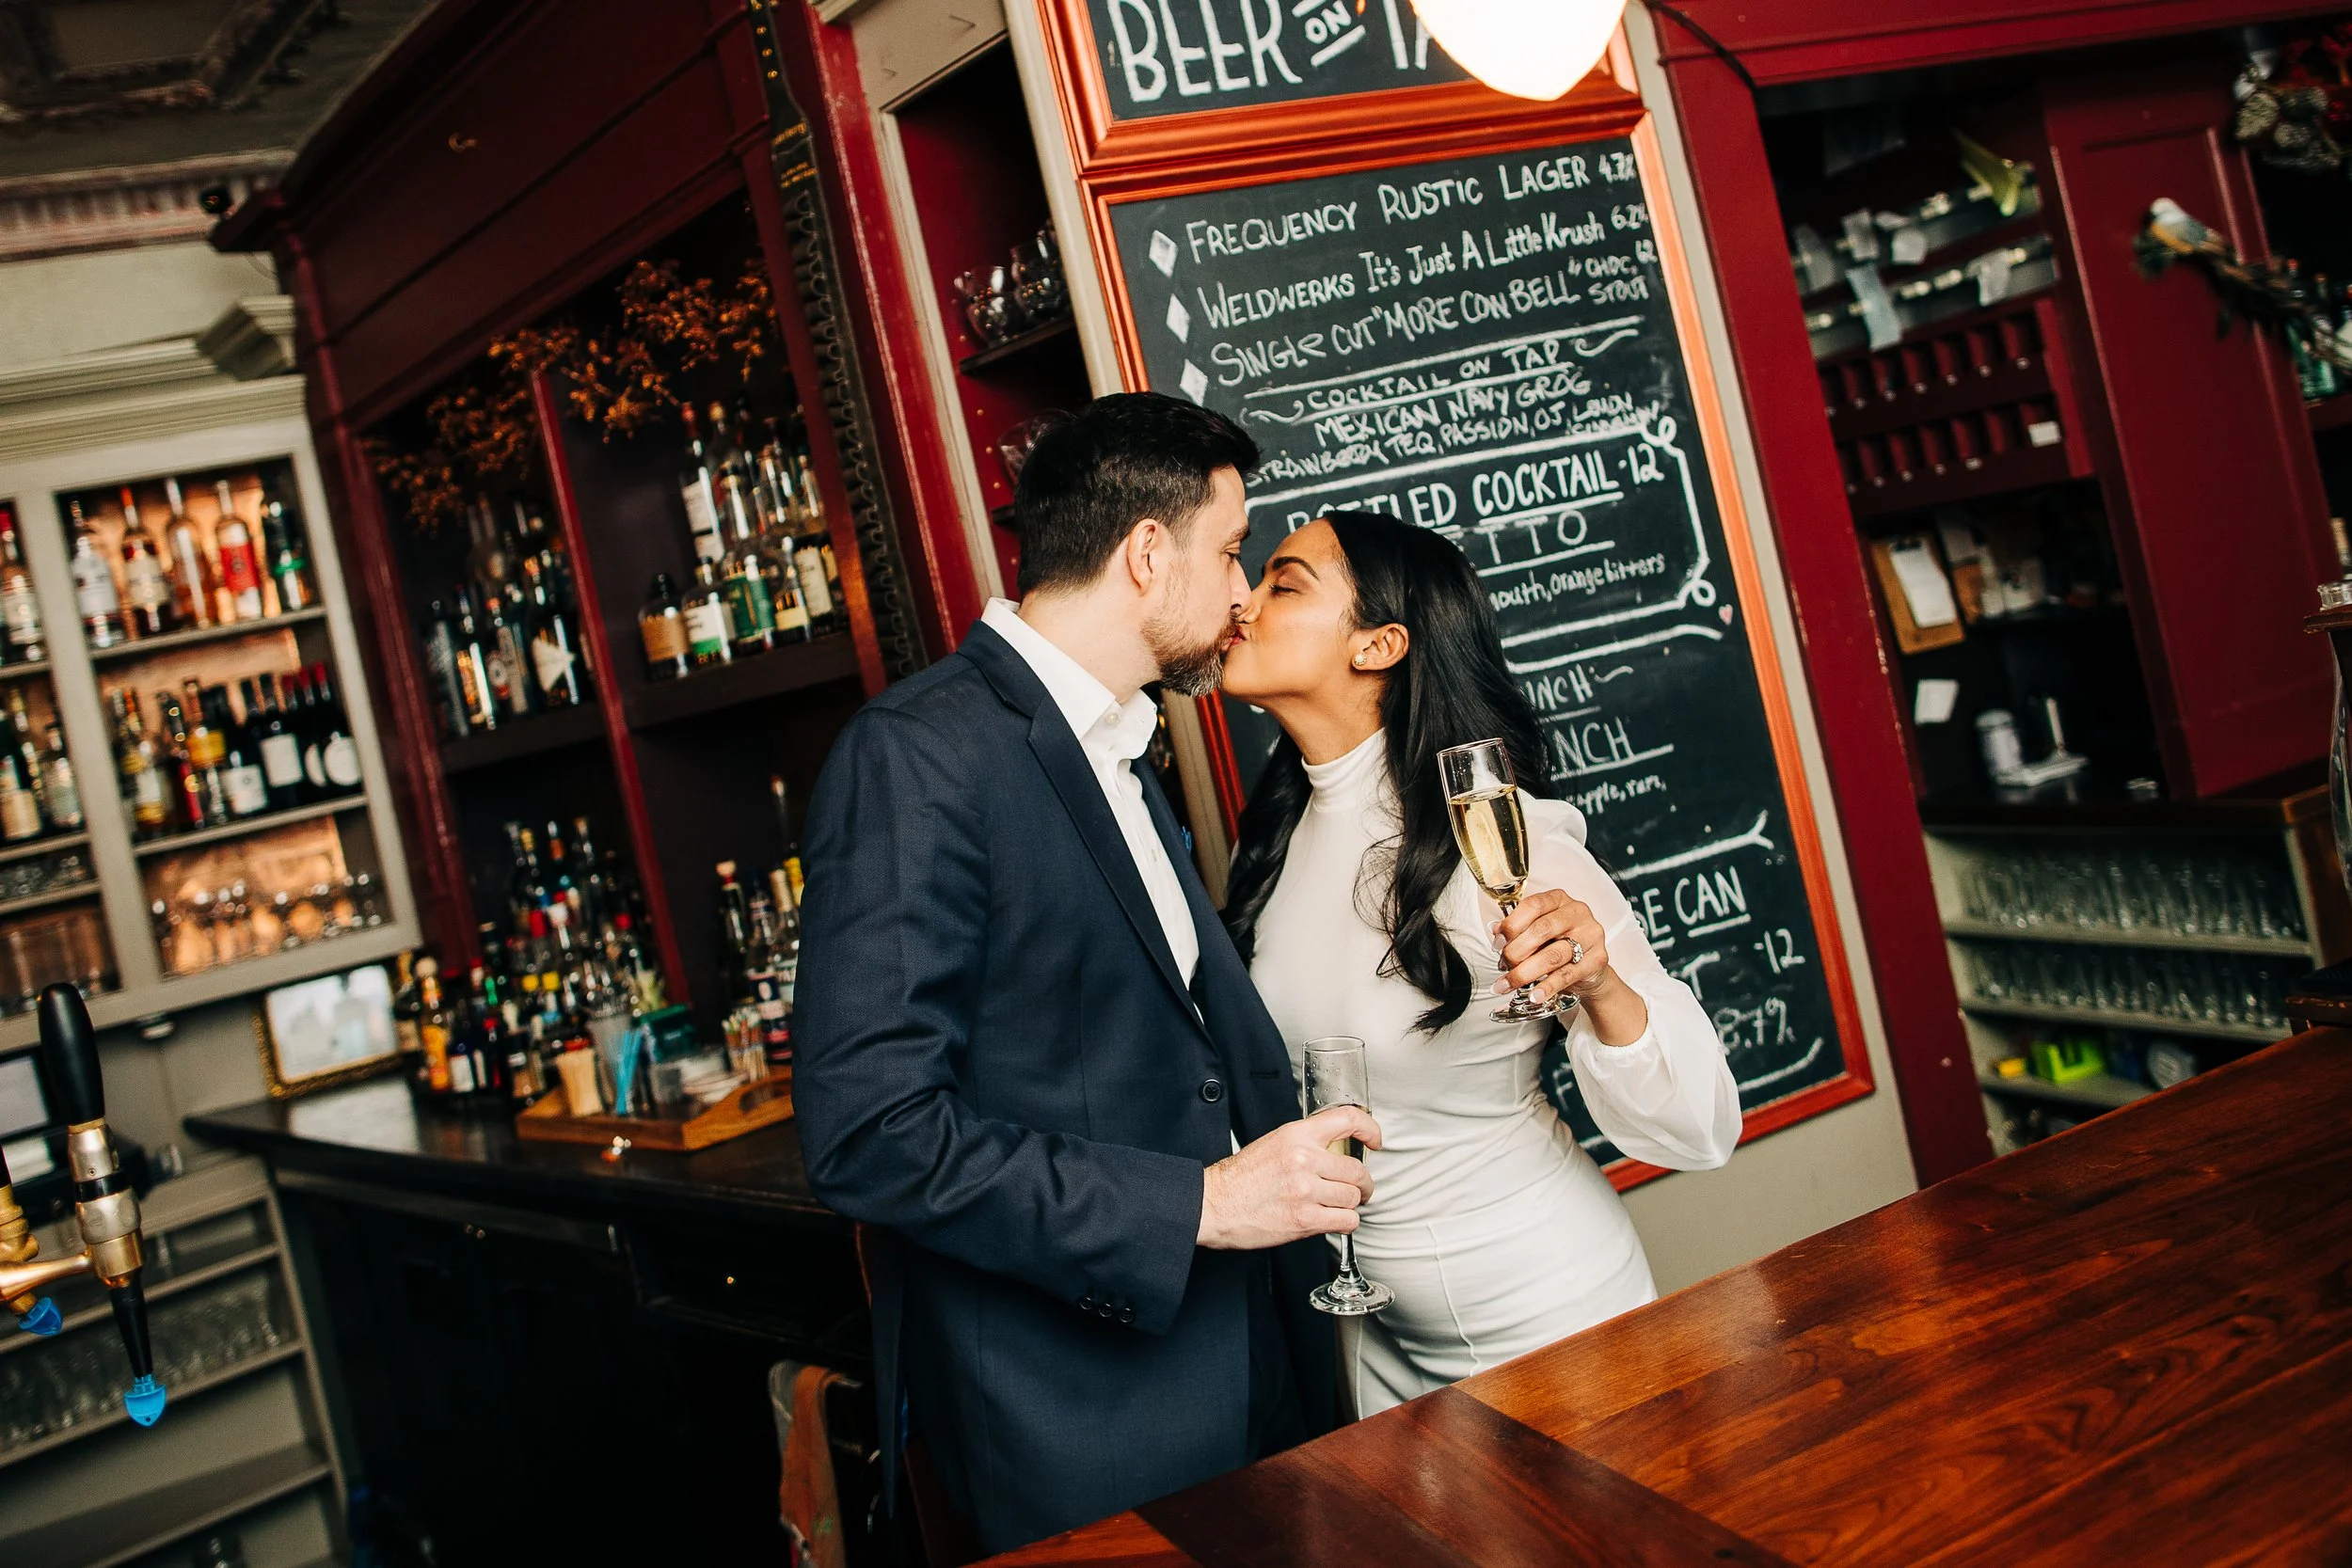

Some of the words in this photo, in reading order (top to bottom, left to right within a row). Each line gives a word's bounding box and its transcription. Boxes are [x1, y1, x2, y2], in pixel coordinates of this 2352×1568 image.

[1106, 0, 1303, 103] BEER
[1304, 0, 1353, 44] ON
[1185, 200, 1358, 264] FREQUENCY
[1376, 177, 1484, 225] RUSTIC
[1499, 154, 1591, 200] LAGER
[1197, 273, 1356, 329] WELDWERKS
[1358, 250, 1402, 293] It's
[1406, 241, 1455, 285] Just
[1462, 230, 1485, 271] A
[1331, 315, 1375, 356] CUT
[1307, 373, 1451, 410] COCKTAIL
[1459, 356, 1490, 378] ON
[1502, 339, 1560, 373] TAP
[1314, 399, 1442, 449] MEXICAN
[1447, 387, 1509, 422] NAVY
[1516, 372, 1592, 407] GROG
[1472, 450, 1619, 516] COCKTAIL
[1675, 865, 1747, 926] CAN
